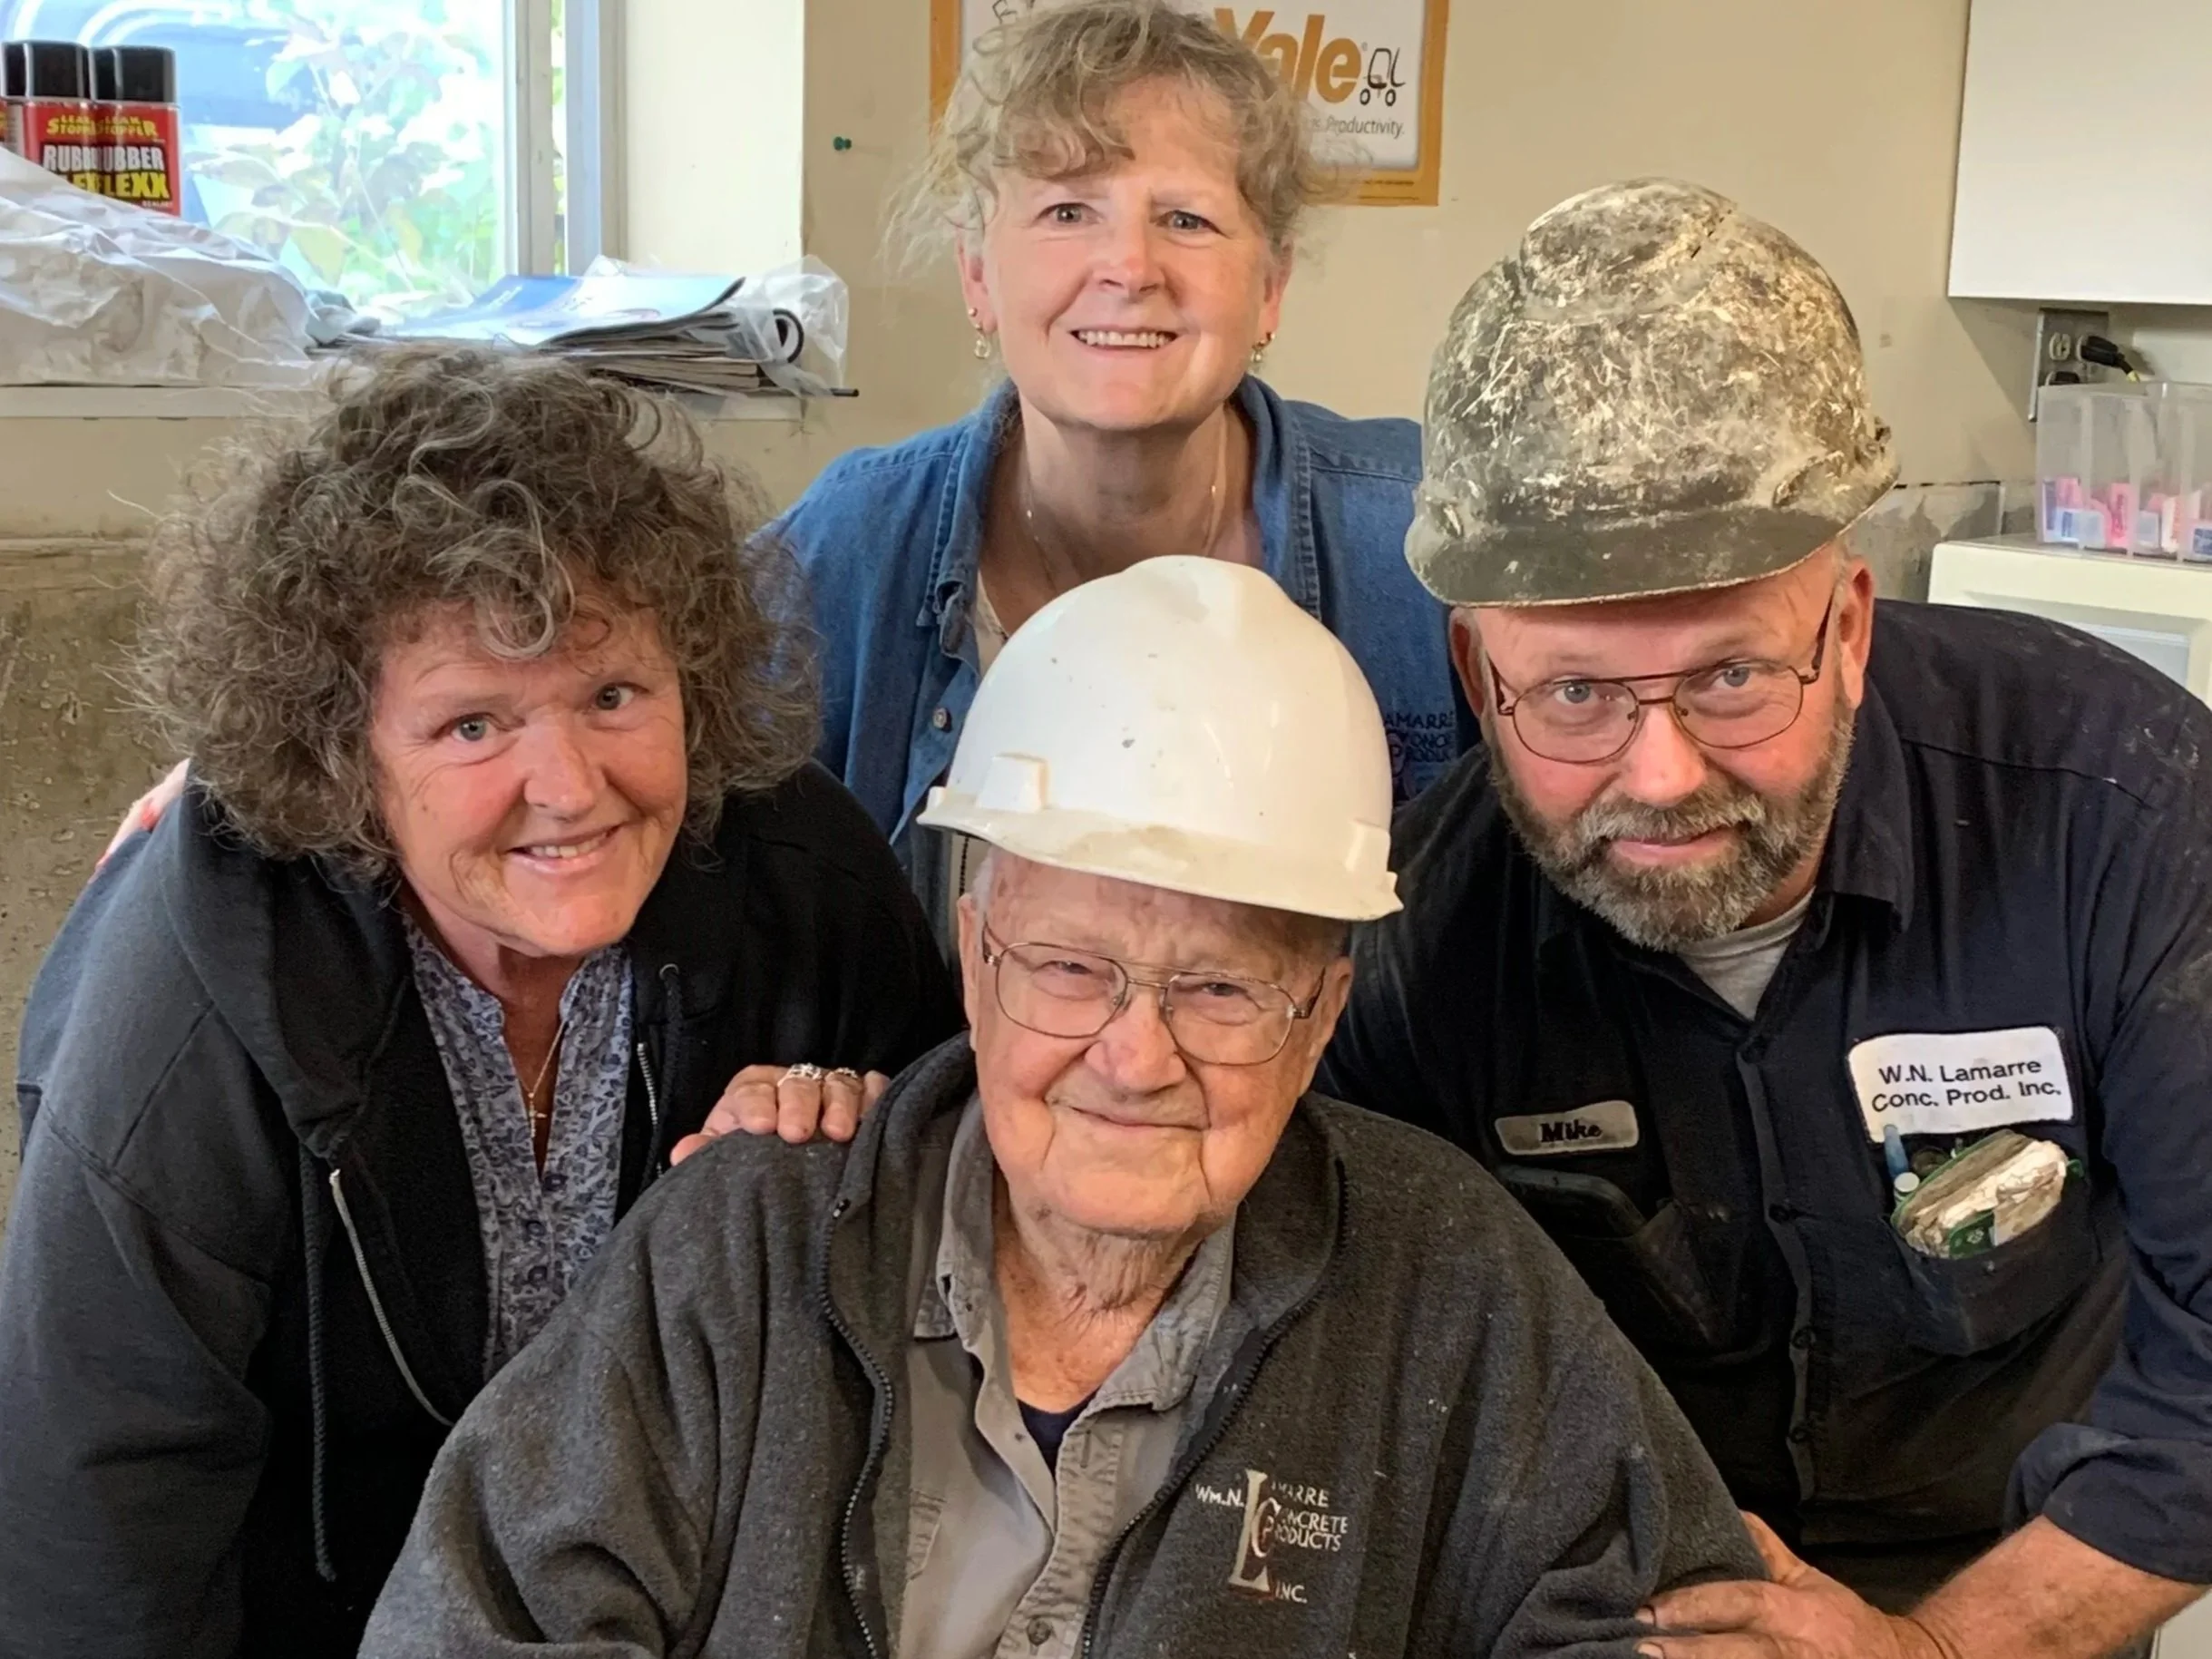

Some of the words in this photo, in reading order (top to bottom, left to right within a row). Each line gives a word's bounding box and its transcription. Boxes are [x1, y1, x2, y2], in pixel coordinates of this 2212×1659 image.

[1878, 1064, 1933, 1085] W.N.
[1940, 1059, 2041, 1083] Lamarre
[1871, 1091, 1939, 1113] Conc.
[1946, 1084, 2011, 1107] Prod.
[2019, 1079, 2061, 1098] Inc.
[1539, 1118, 1603, 1143] Mike
[1275, 1580, 1308, 1604] INC.
